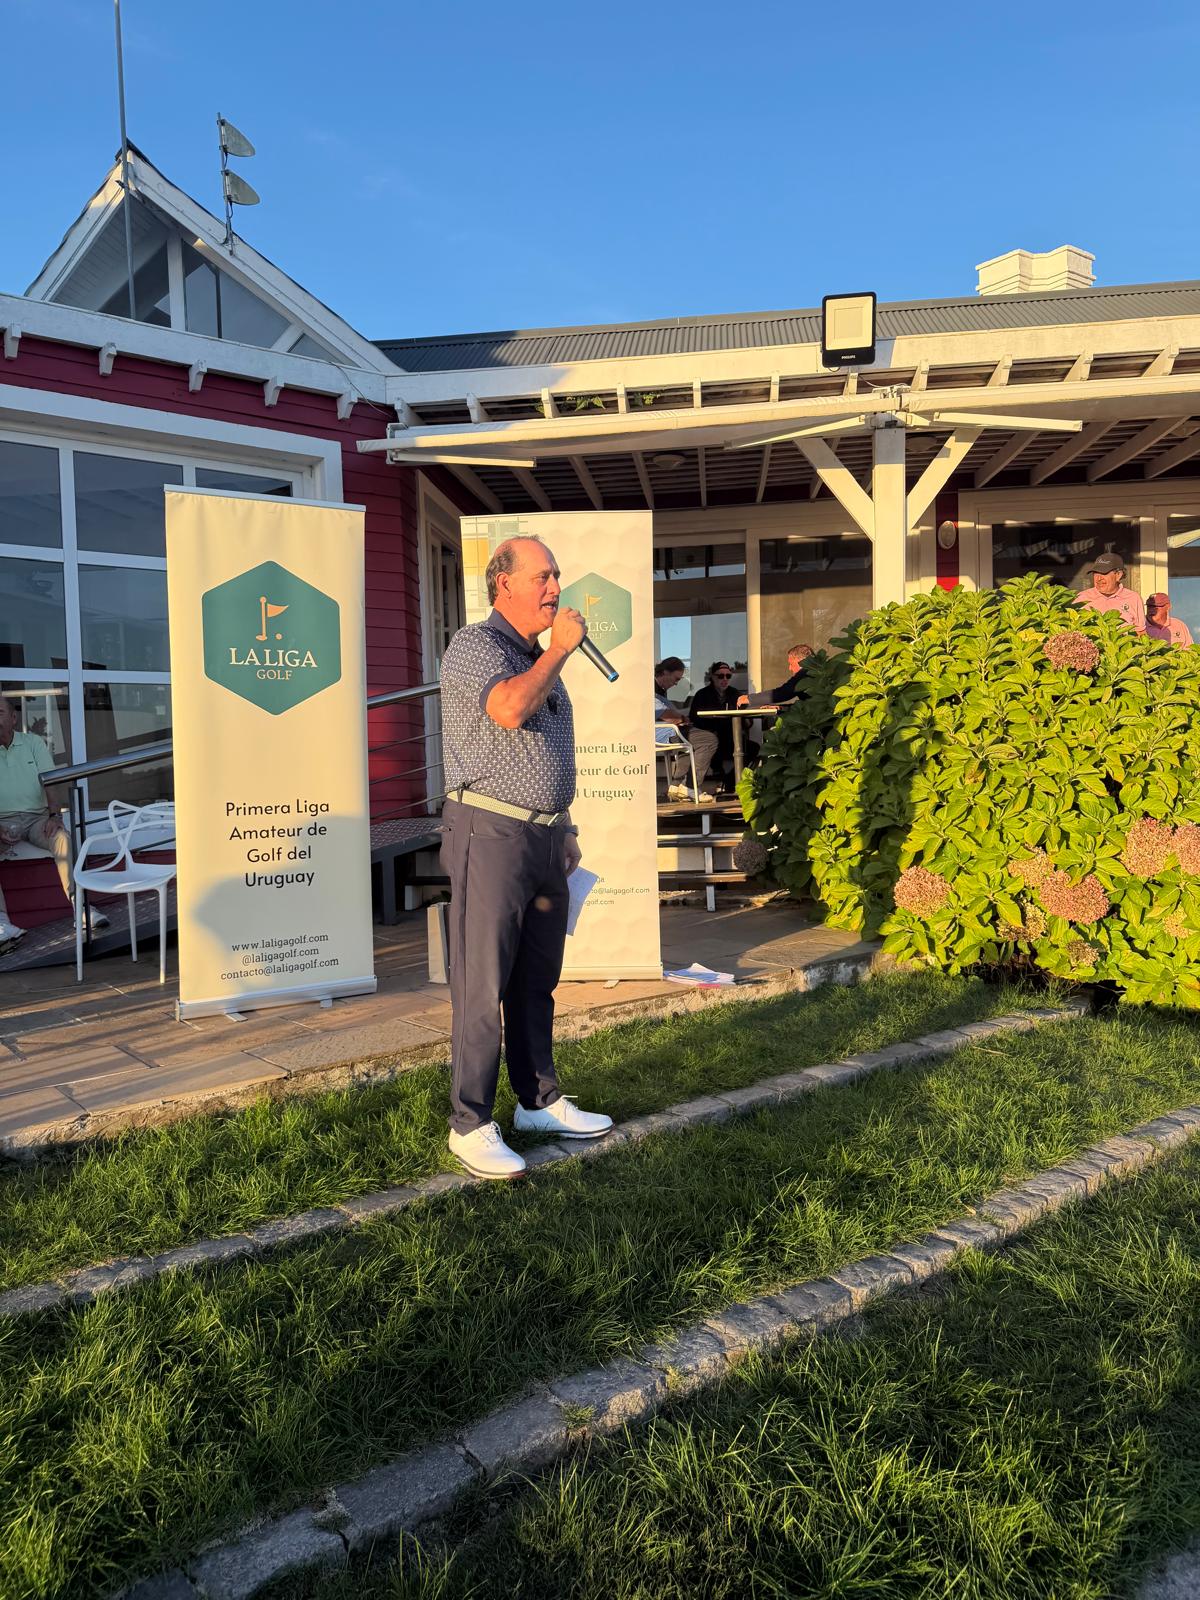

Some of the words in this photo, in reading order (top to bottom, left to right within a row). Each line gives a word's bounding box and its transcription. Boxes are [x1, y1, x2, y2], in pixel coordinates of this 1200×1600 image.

[256, 669, 293, 681] GOLF
[575, 745, 608, 754] mera
[611, 742, 637, 756] Liga
[575, 766, 602, 776] teur
[604, 764, 620, 776] de
[622, 763, 650, 776] Golf
[583, 787, 636, 802] Uruguay
[226, 802, 291, 817] Primera
[296, 798, 330, 817] Liga
[229, 825, 303, 841] Amateur
[307, 822, 328, 838] de
[247, 847, 282, 863] Golf
[287, 845, 312, 861] del
[245, 870, 315, 889] Uruguay
[231, 933, 329, 952] www.laligagolf.com
[242, 947, 320, 966] @laligagolf.com
[220, 957, 340, 981] contacto@laligagolf.com
